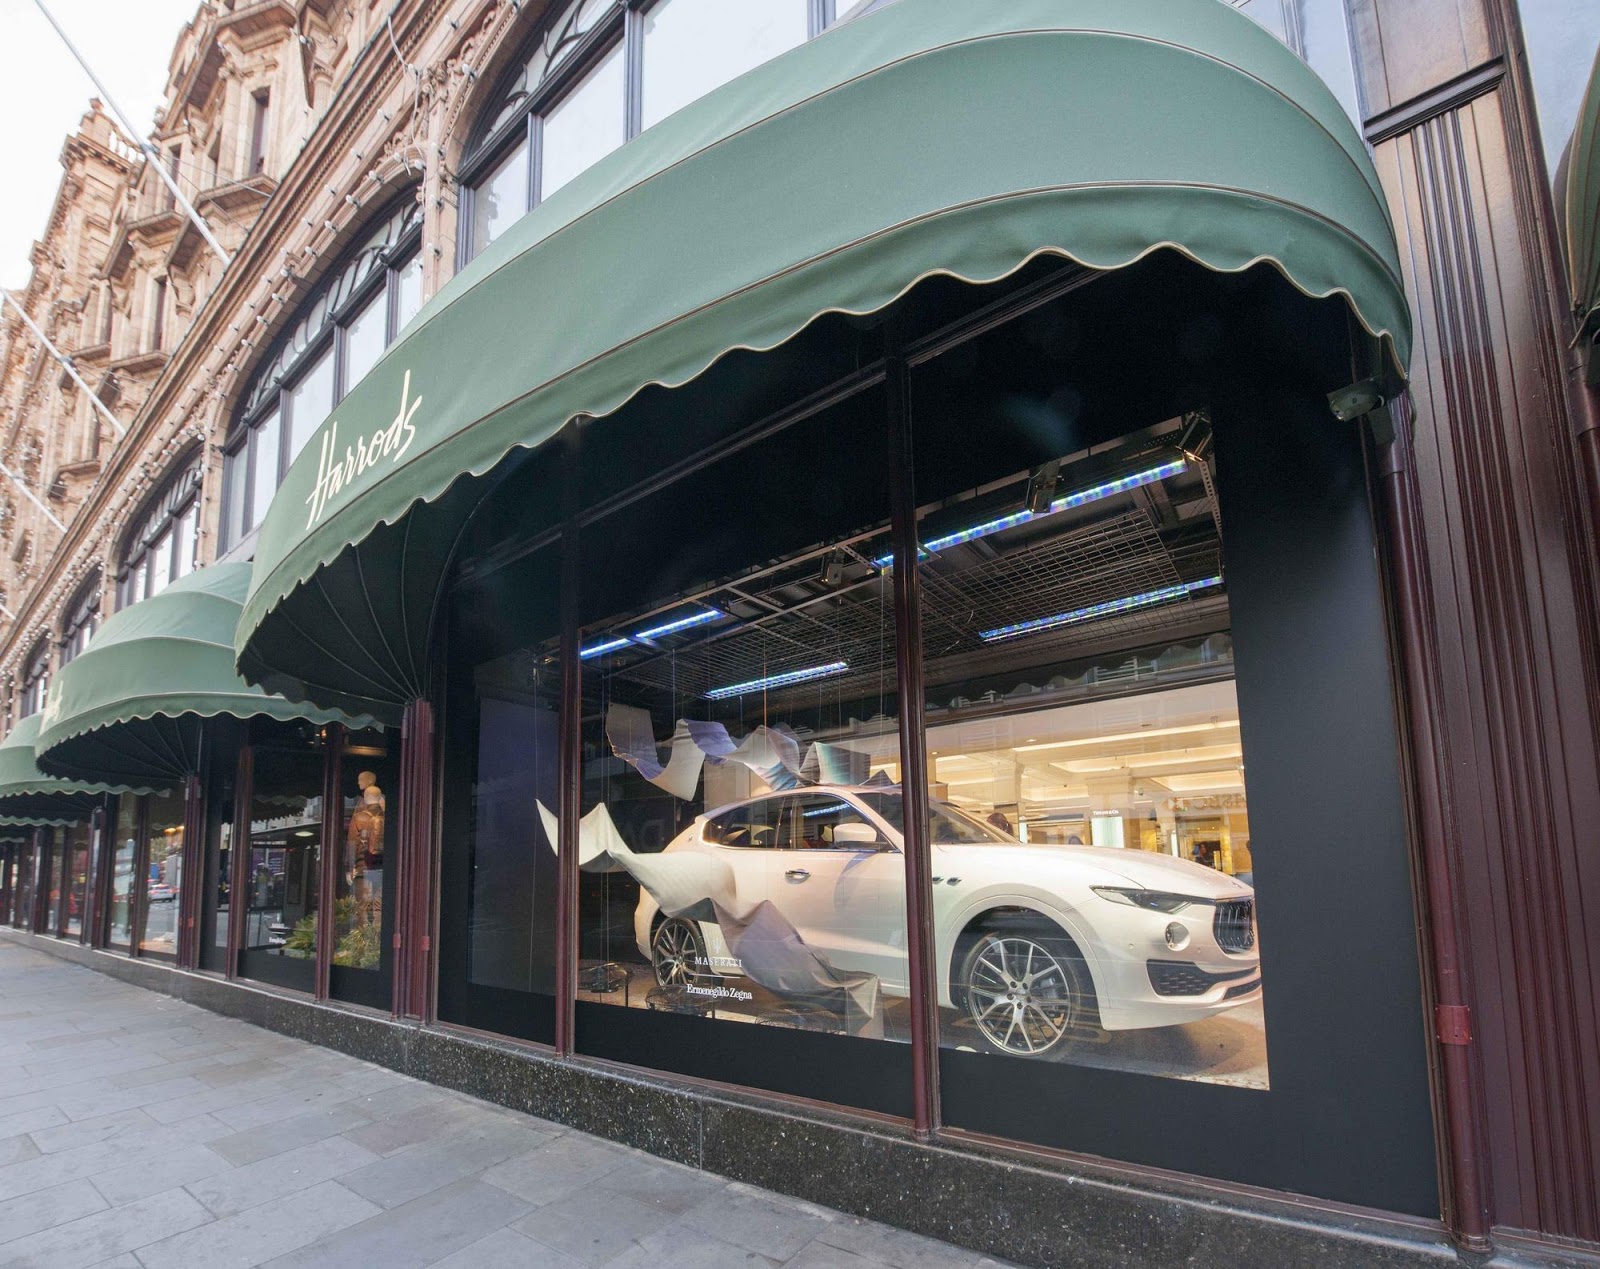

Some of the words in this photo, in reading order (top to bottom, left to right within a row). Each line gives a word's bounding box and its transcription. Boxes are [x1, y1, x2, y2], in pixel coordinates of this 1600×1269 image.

[305, 368, 423, 531] Harrods
[694, 956, 743, 968] MASERATI
[686, 983, 730, 999] Ermenegildo
[729, 987, 753, 1002] Zegna
